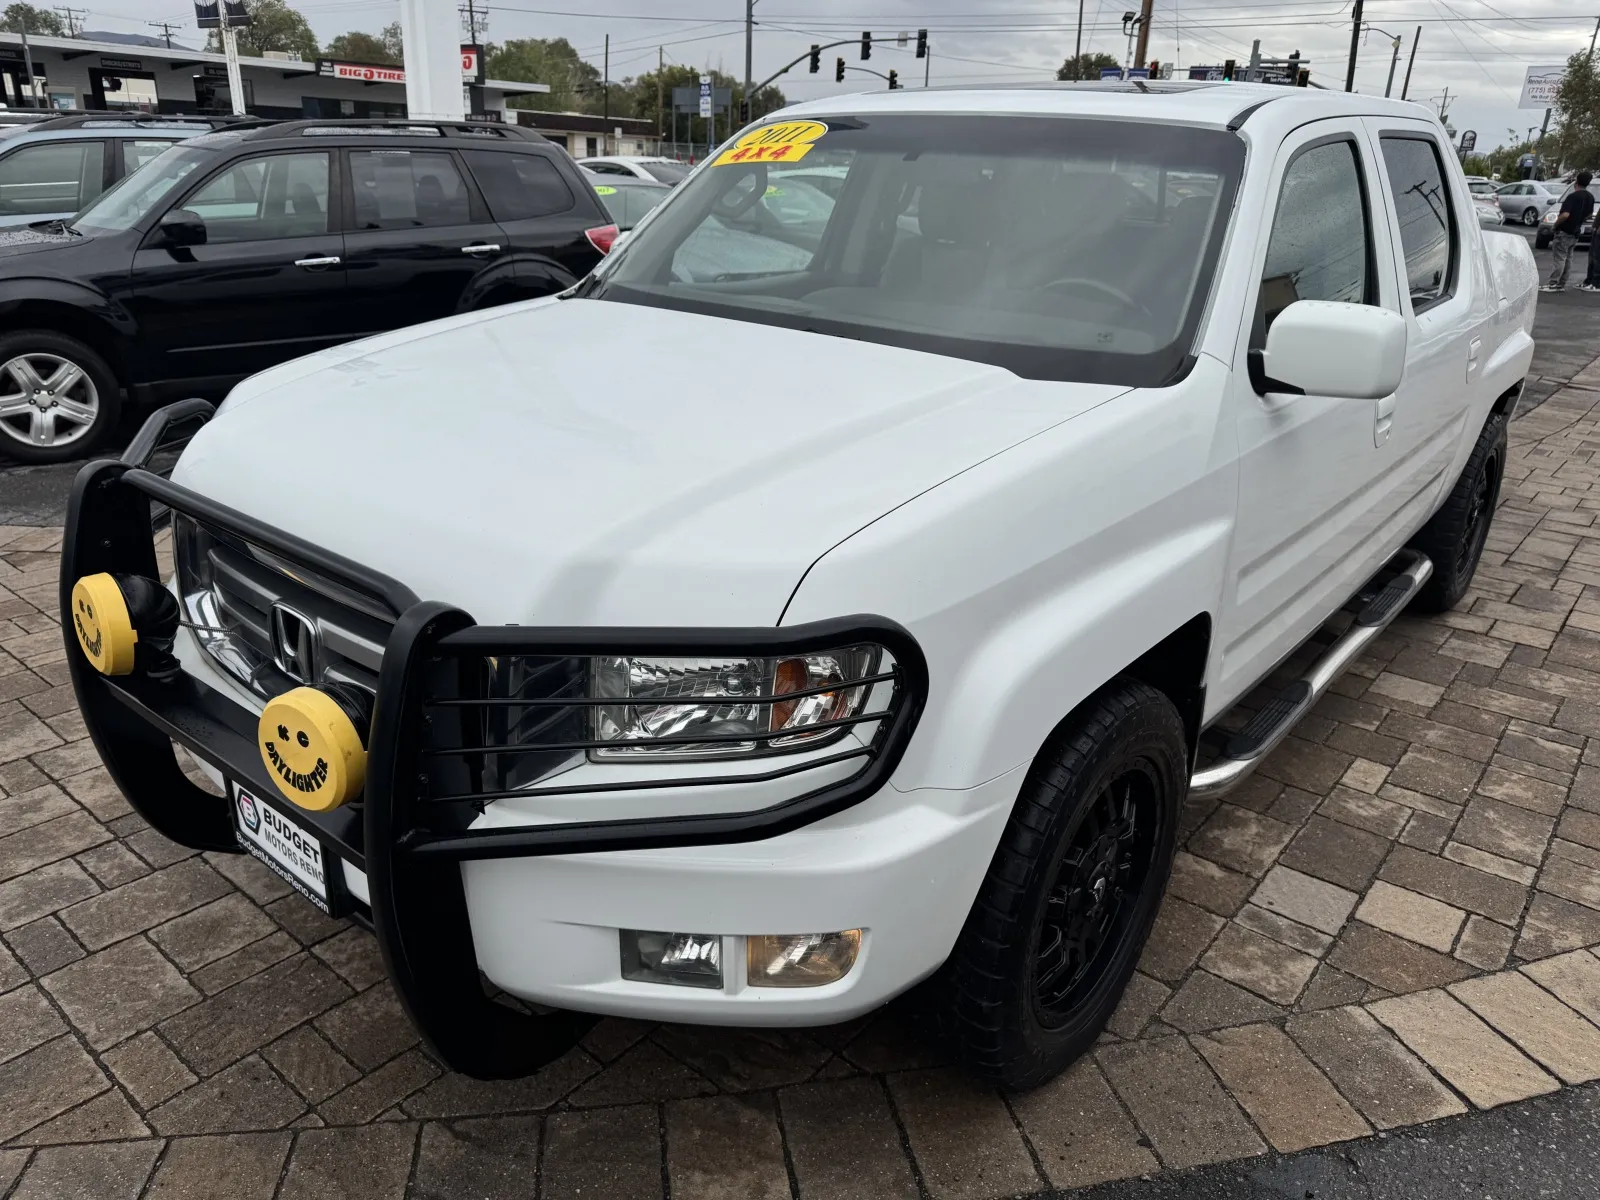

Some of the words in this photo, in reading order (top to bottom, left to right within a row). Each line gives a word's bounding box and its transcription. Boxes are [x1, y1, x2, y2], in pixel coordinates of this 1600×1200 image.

[339, 68, 362, 77] BIG
[363, 69, 375, 80] O
[743, 125, 816, 147] 2011
[265, 742, 328, 793] DAYLIGHTER
[263, 807, 320, 864] BUDGET
[264, 828, 299, 866] MOTORS
[300, 858, 325, 884] RENO
[236, 831, 330, 914] BudgetMotorsReno.com
